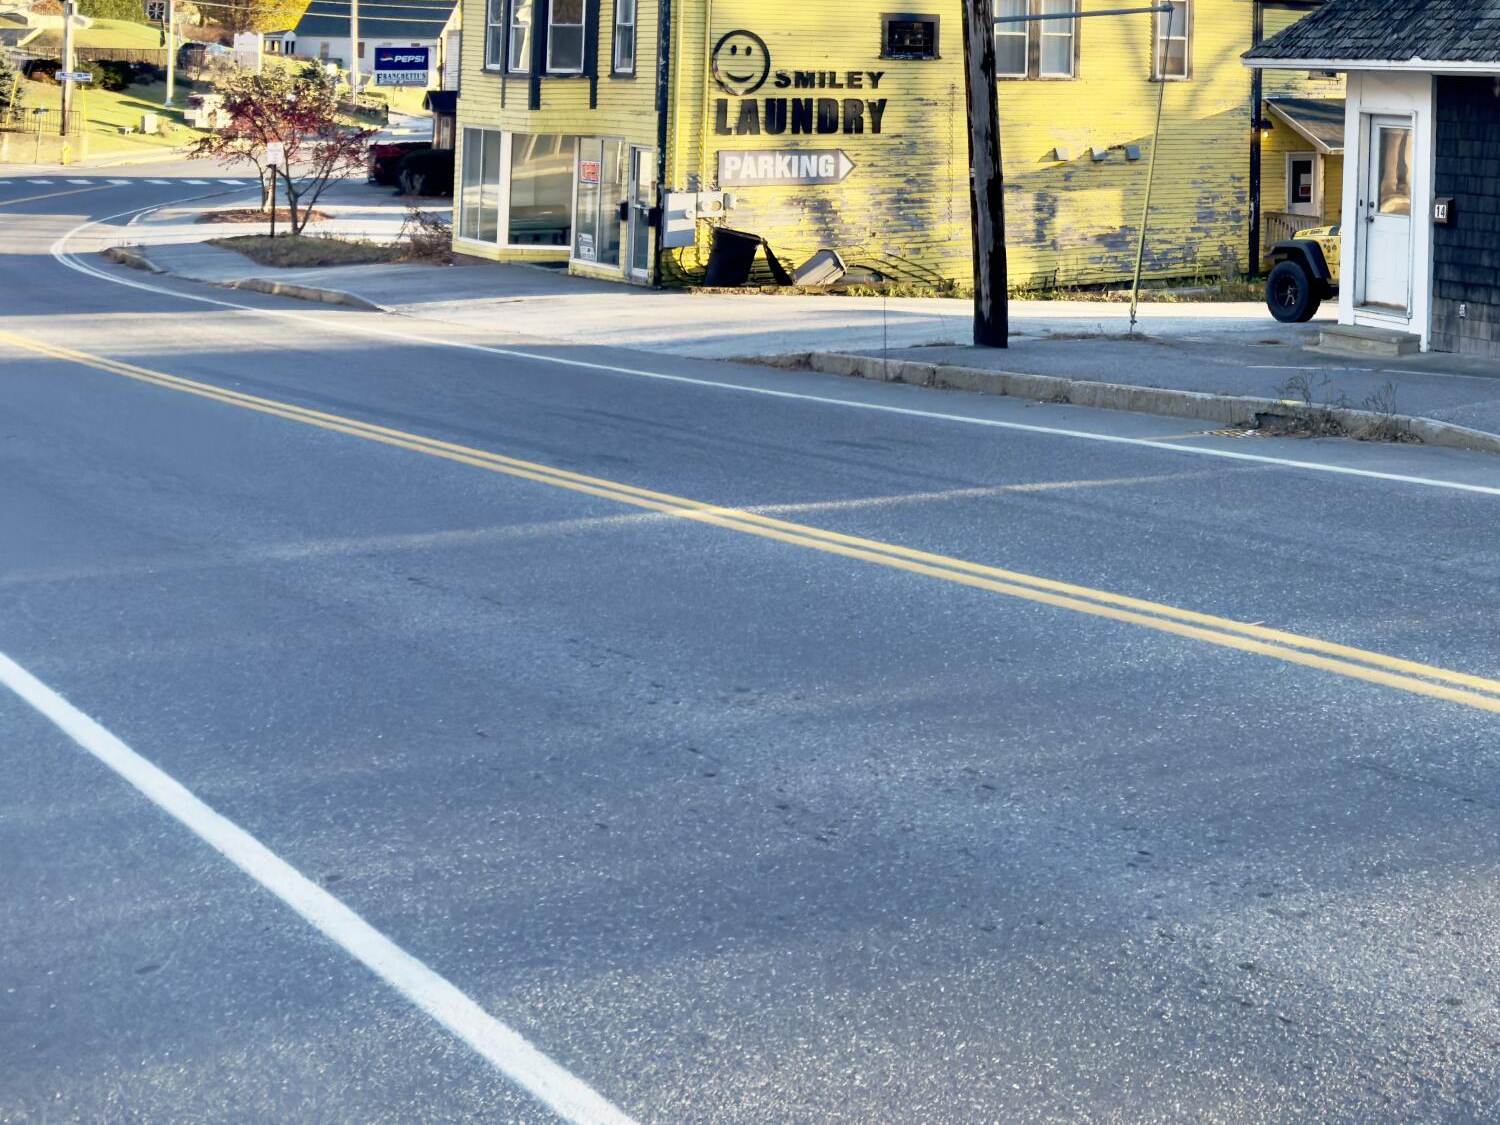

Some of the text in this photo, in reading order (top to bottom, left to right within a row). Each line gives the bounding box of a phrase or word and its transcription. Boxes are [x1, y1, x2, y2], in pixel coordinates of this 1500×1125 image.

[393, 55, 425, 63] PEPSI
[774, 69, 885, 89] SMILEY
[715, 98, 888, 136] LAUNDRY
[724, 152, 835, 180] PARKING
[1436, 205, 1445, 218] 14
